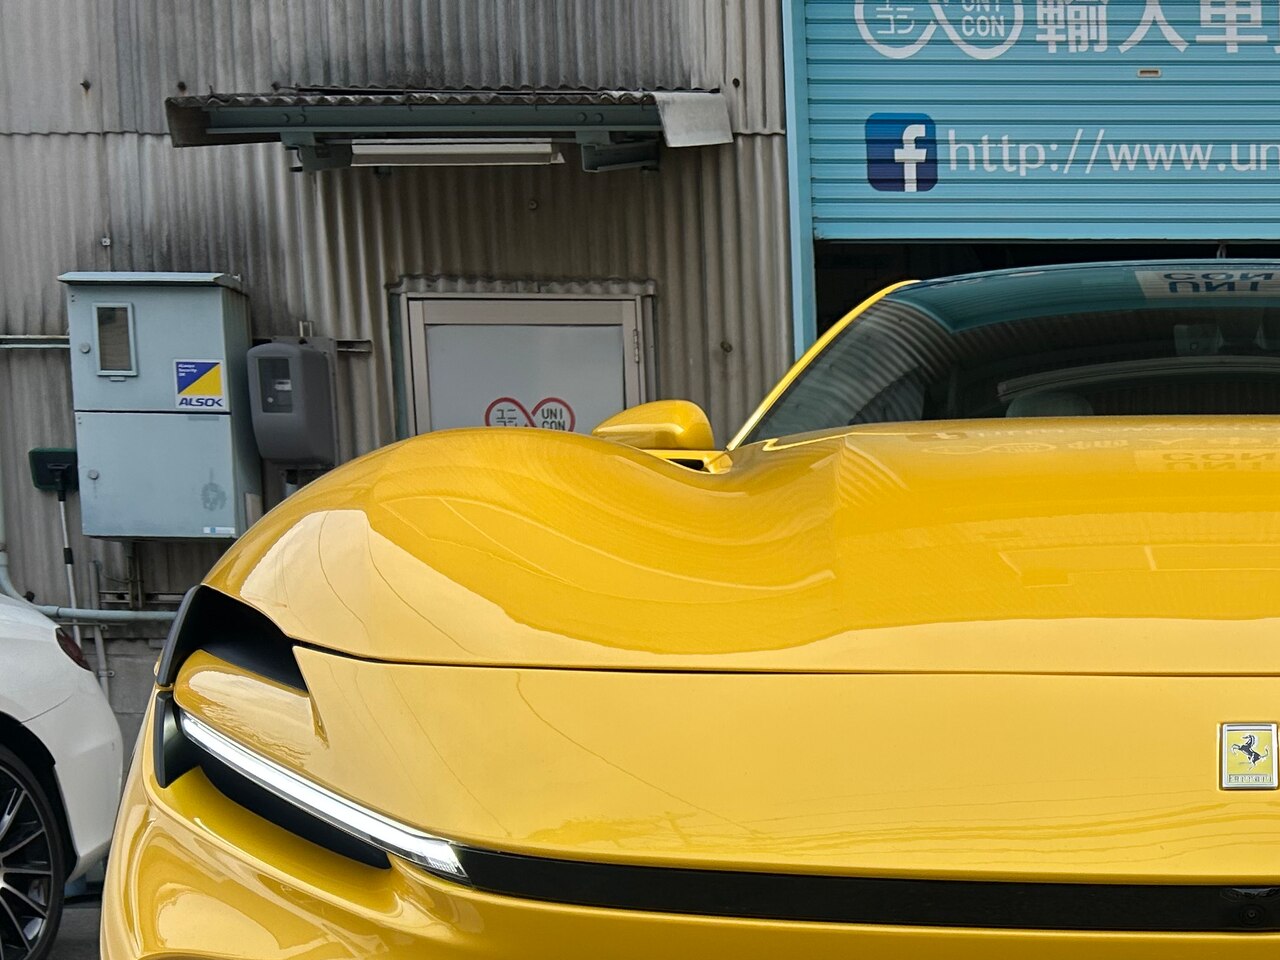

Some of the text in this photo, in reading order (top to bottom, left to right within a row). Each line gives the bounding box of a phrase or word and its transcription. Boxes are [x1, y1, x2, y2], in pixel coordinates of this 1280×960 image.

[876, 14, 915, 34] コン
[961, 15, 1005, 37] CON
[178, 397, 223, 407] ALSOK
[541, 408, 563, 420] UNI
